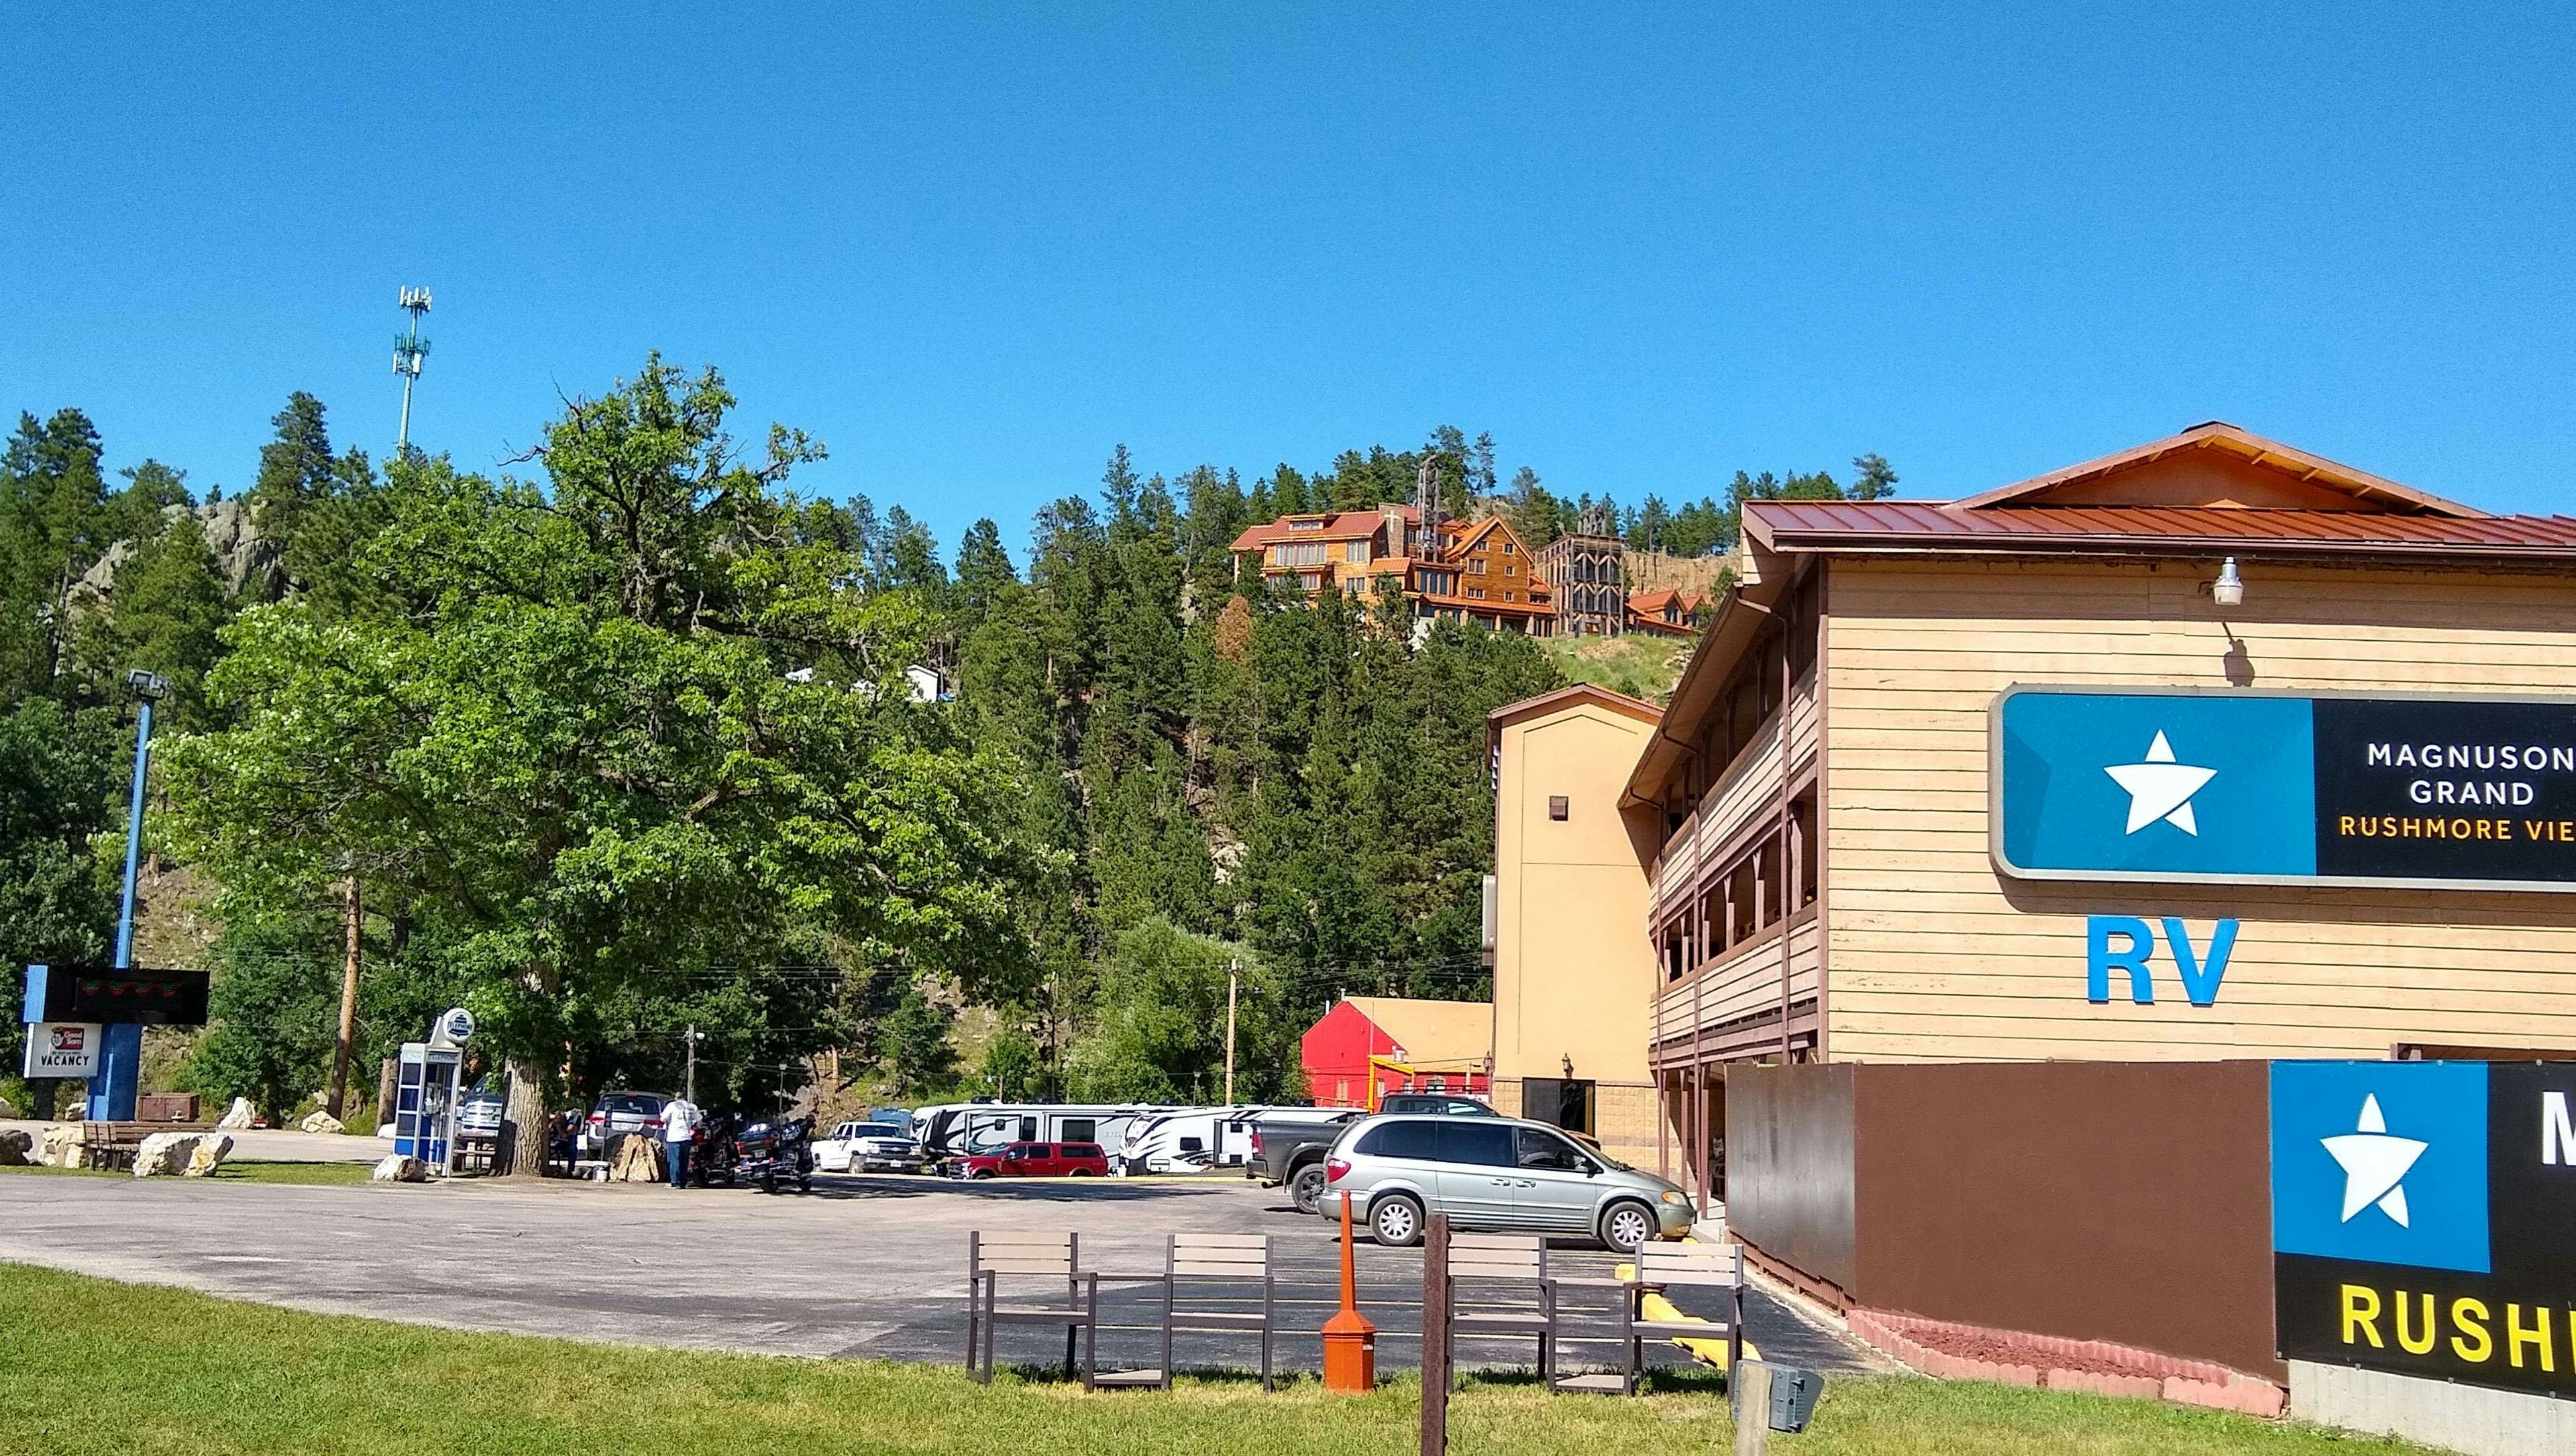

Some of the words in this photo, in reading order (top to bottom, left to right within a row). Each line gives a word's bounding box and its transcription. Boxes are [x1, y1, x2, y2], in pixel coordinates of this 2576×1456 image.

[2367, 743, 2574, 771] MAGNUSON
[2410, 780, 2534, 806] GRAND
[2340, 816, 2512, 839] RUSHMORE
[2087, 915, 2241, 1007] RV
[64, 1031, 83, 1039] Good
[41, 1055, 89, 1066] VACANCY
[2341, 1284, 2576, 1375] RUSH
